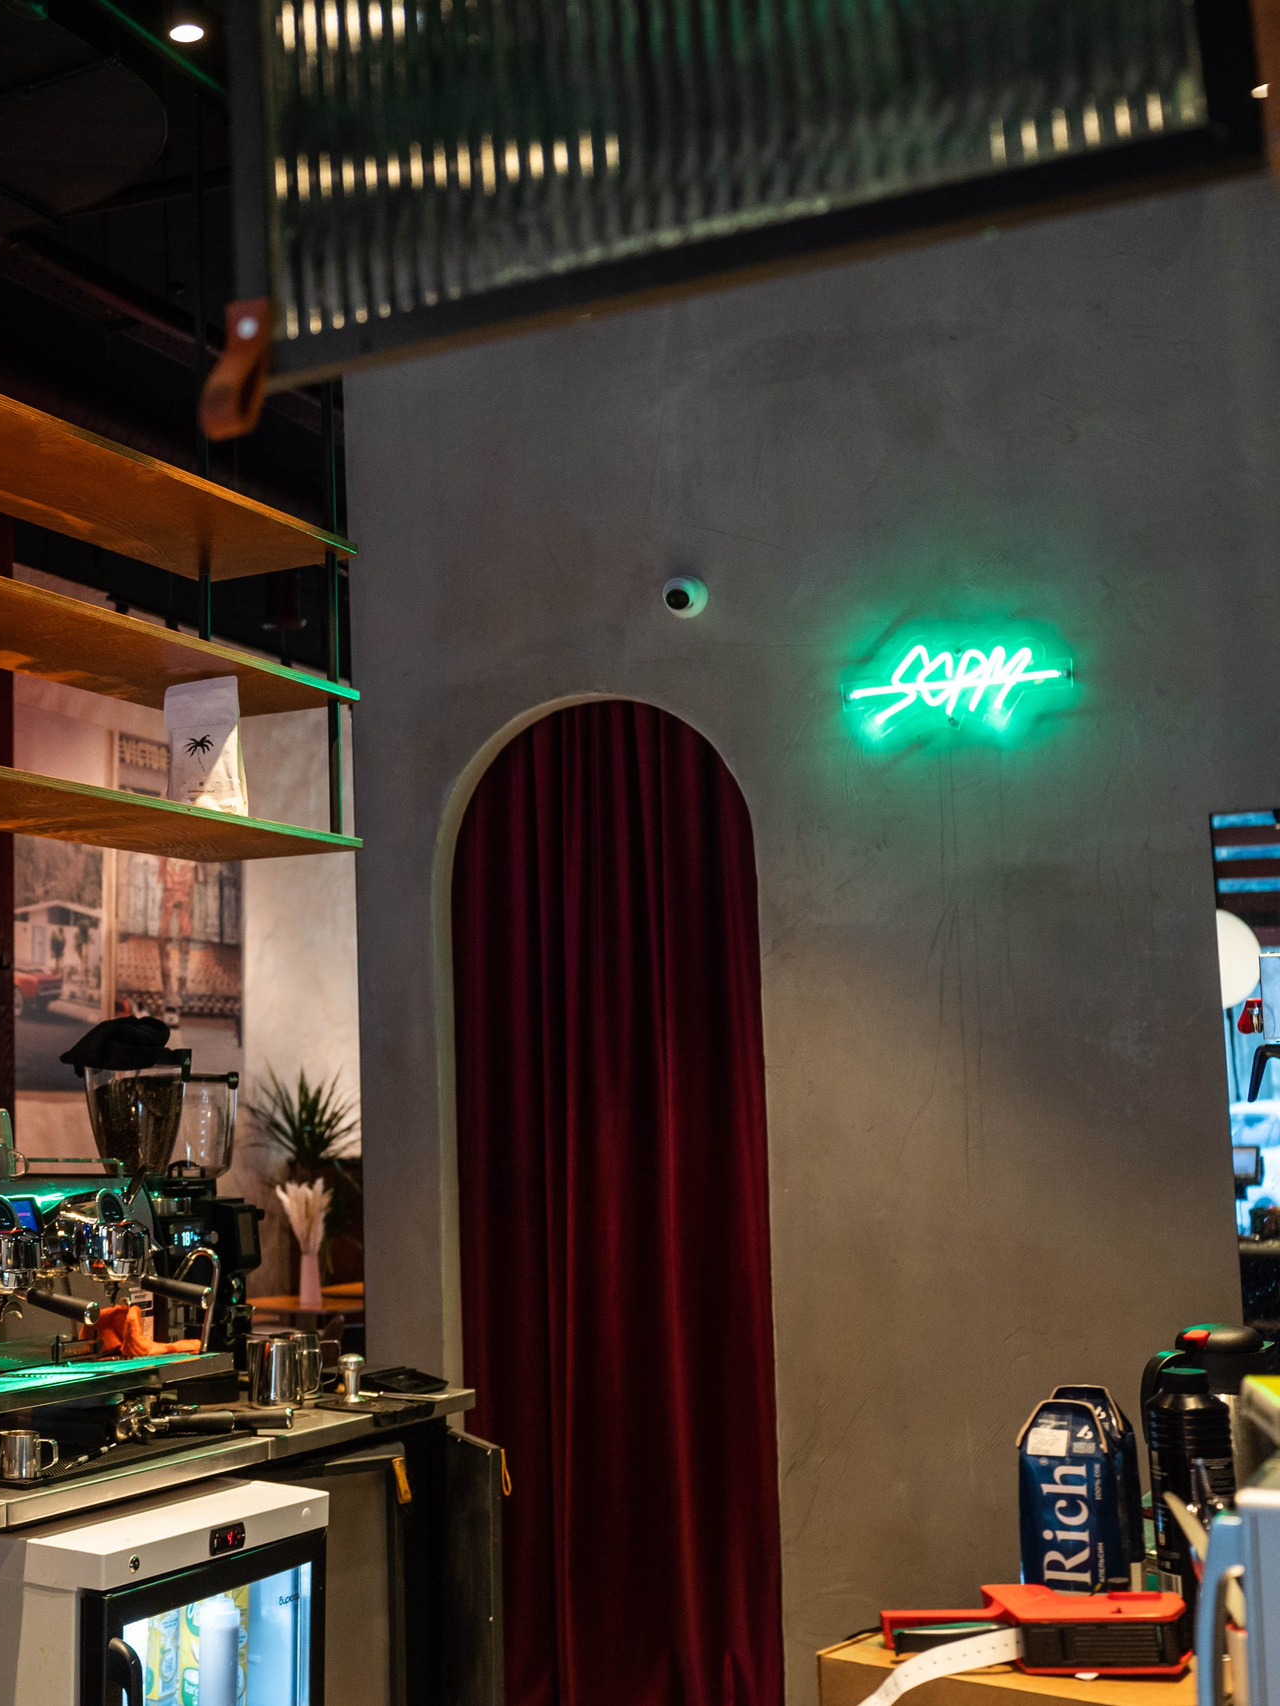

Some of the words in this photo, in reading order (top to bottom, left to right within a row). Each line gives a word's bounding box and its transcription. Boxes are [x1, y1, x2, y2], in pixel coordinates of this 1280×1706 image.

[1094, 1477, 1102, 1500] 100%
[227, 1531, 233, 1545] 4
[1040, 1463, 1092, 1586] Rich
[1097, 1542, 1105, 1583] АПЕЛЬСИН
